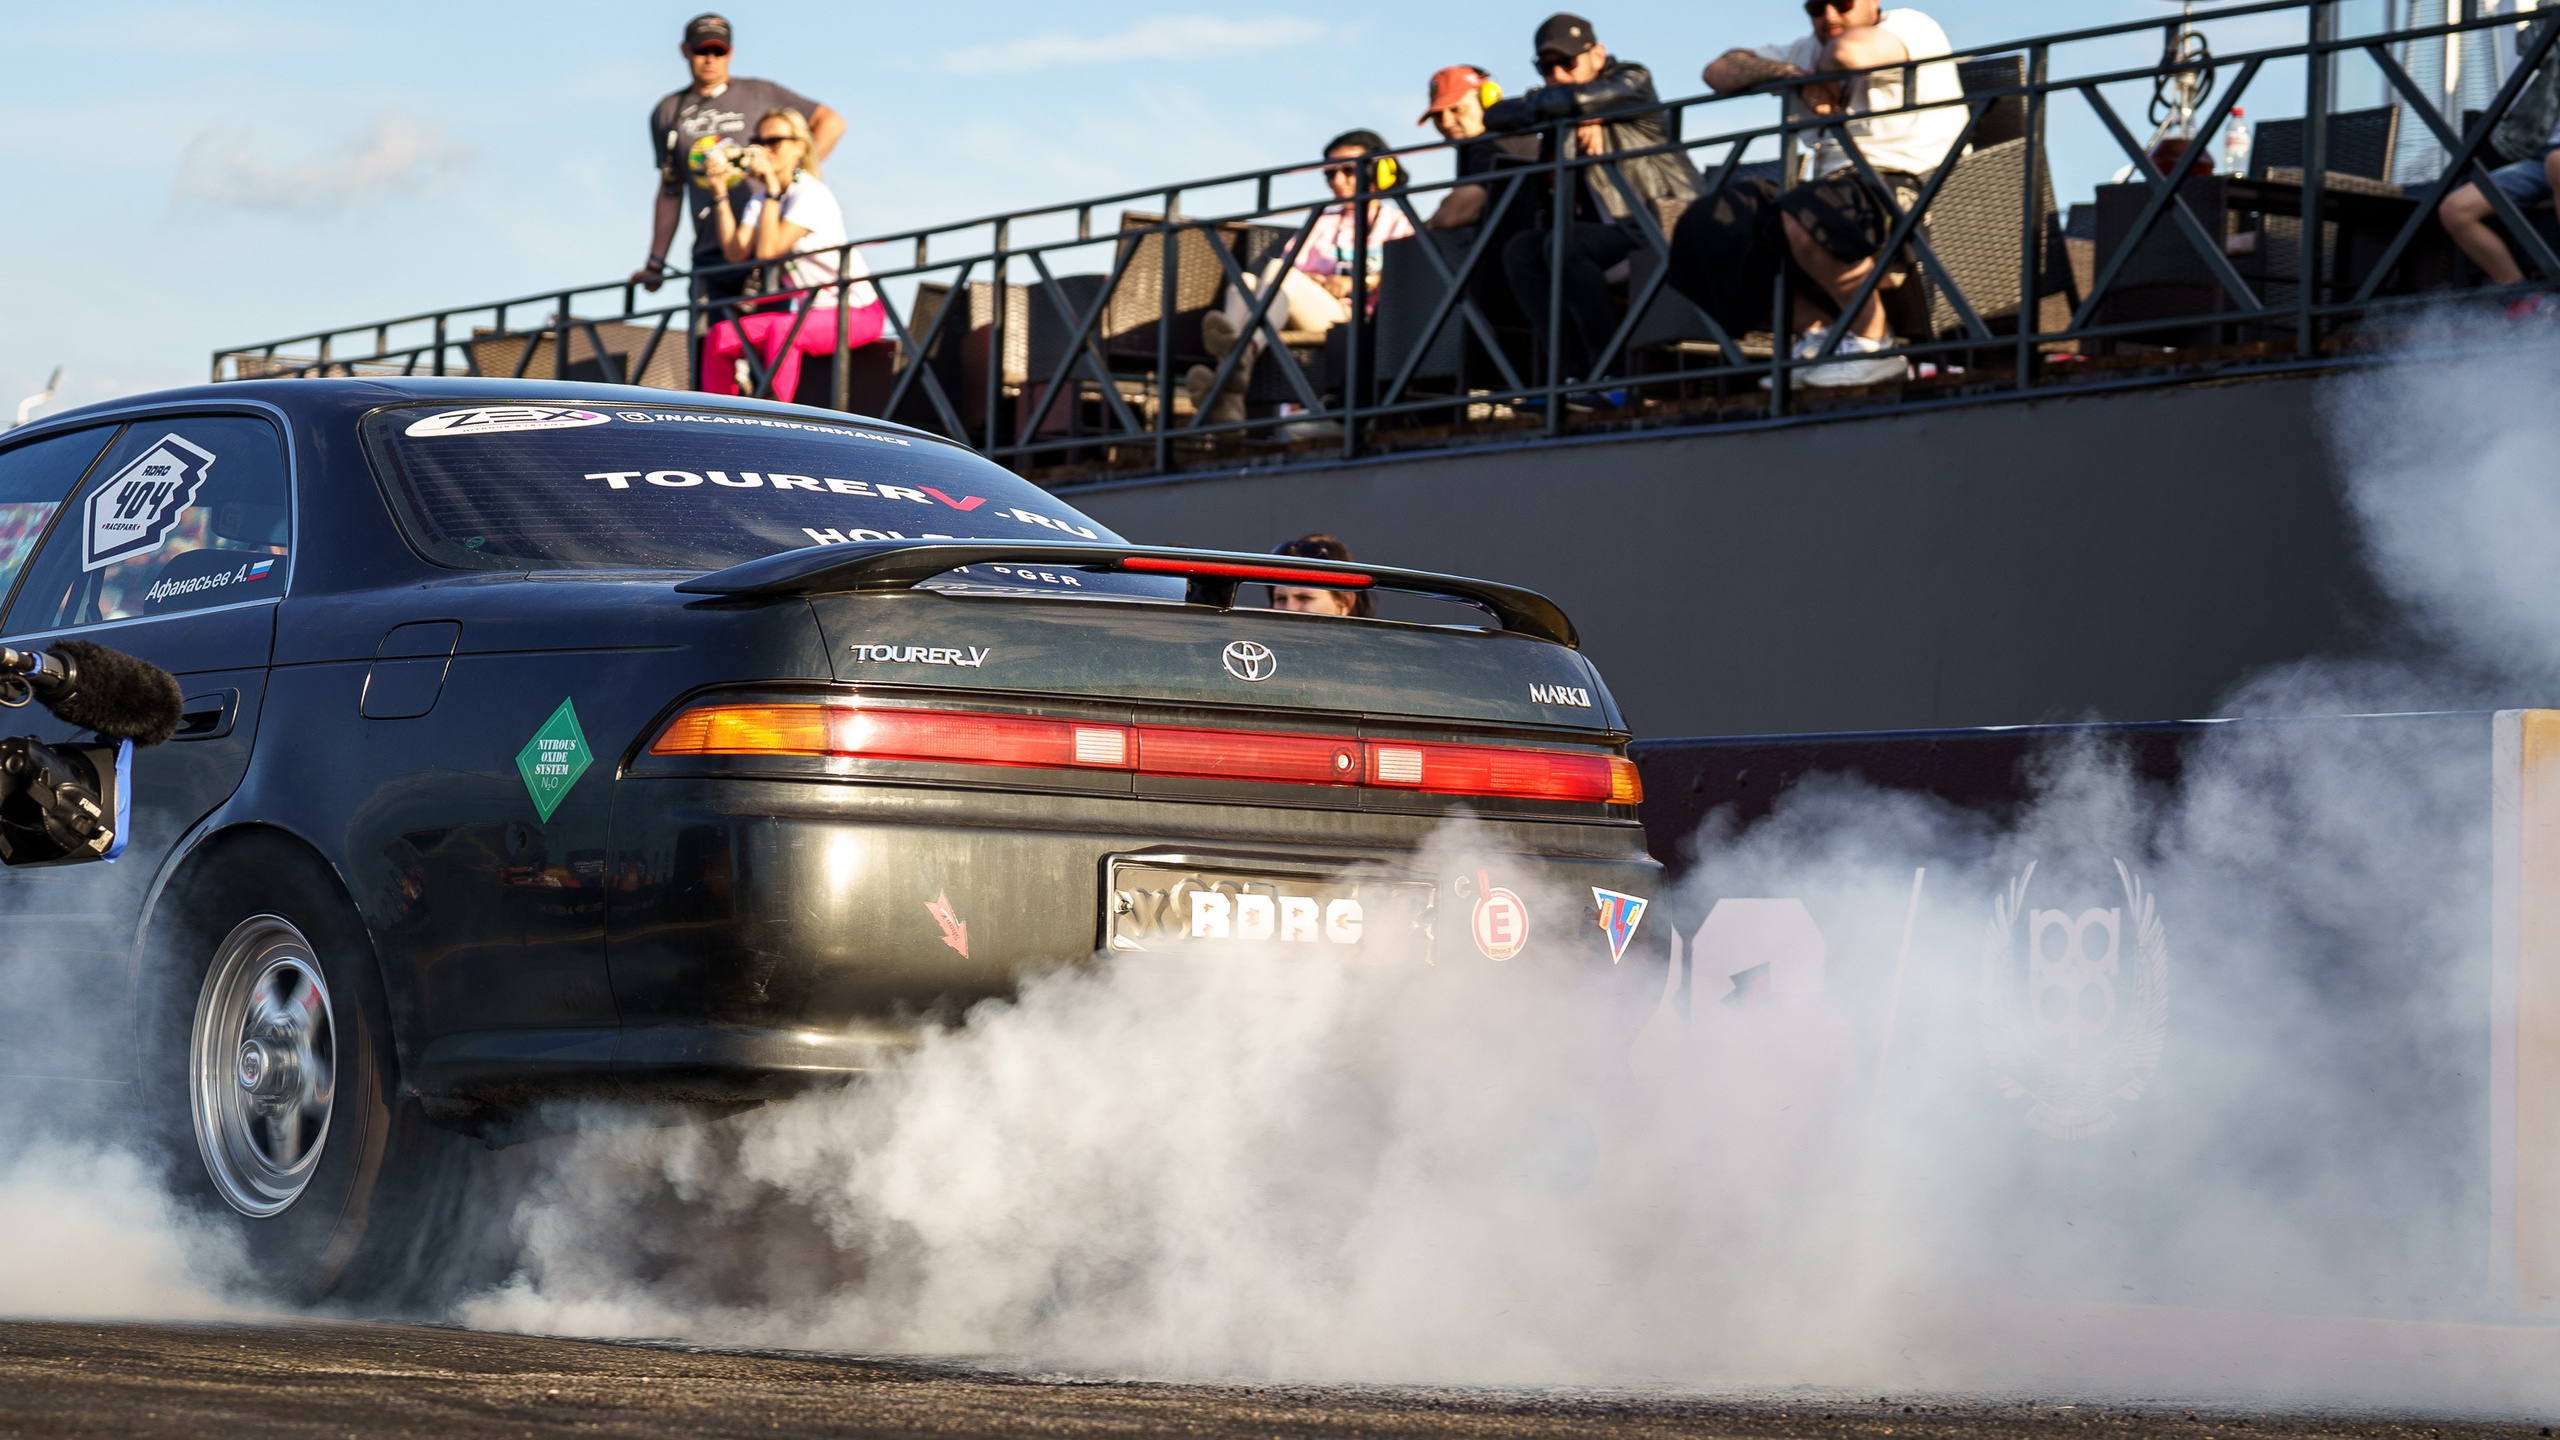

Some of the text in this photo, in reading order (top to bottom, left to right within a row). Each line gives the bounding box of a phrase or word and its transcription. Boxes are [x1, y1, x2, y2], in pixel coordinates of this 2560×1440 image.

[113, 481, 175, 520] 404
[144, 563, 248, 603] Афанасьев А.
[537, 739, 577, 751] NITROUS
[541, 751, 568, 763] OXIDE
[534, 764, 570, 775] SYSTEM
[1488, 904, 1512, 944] E
